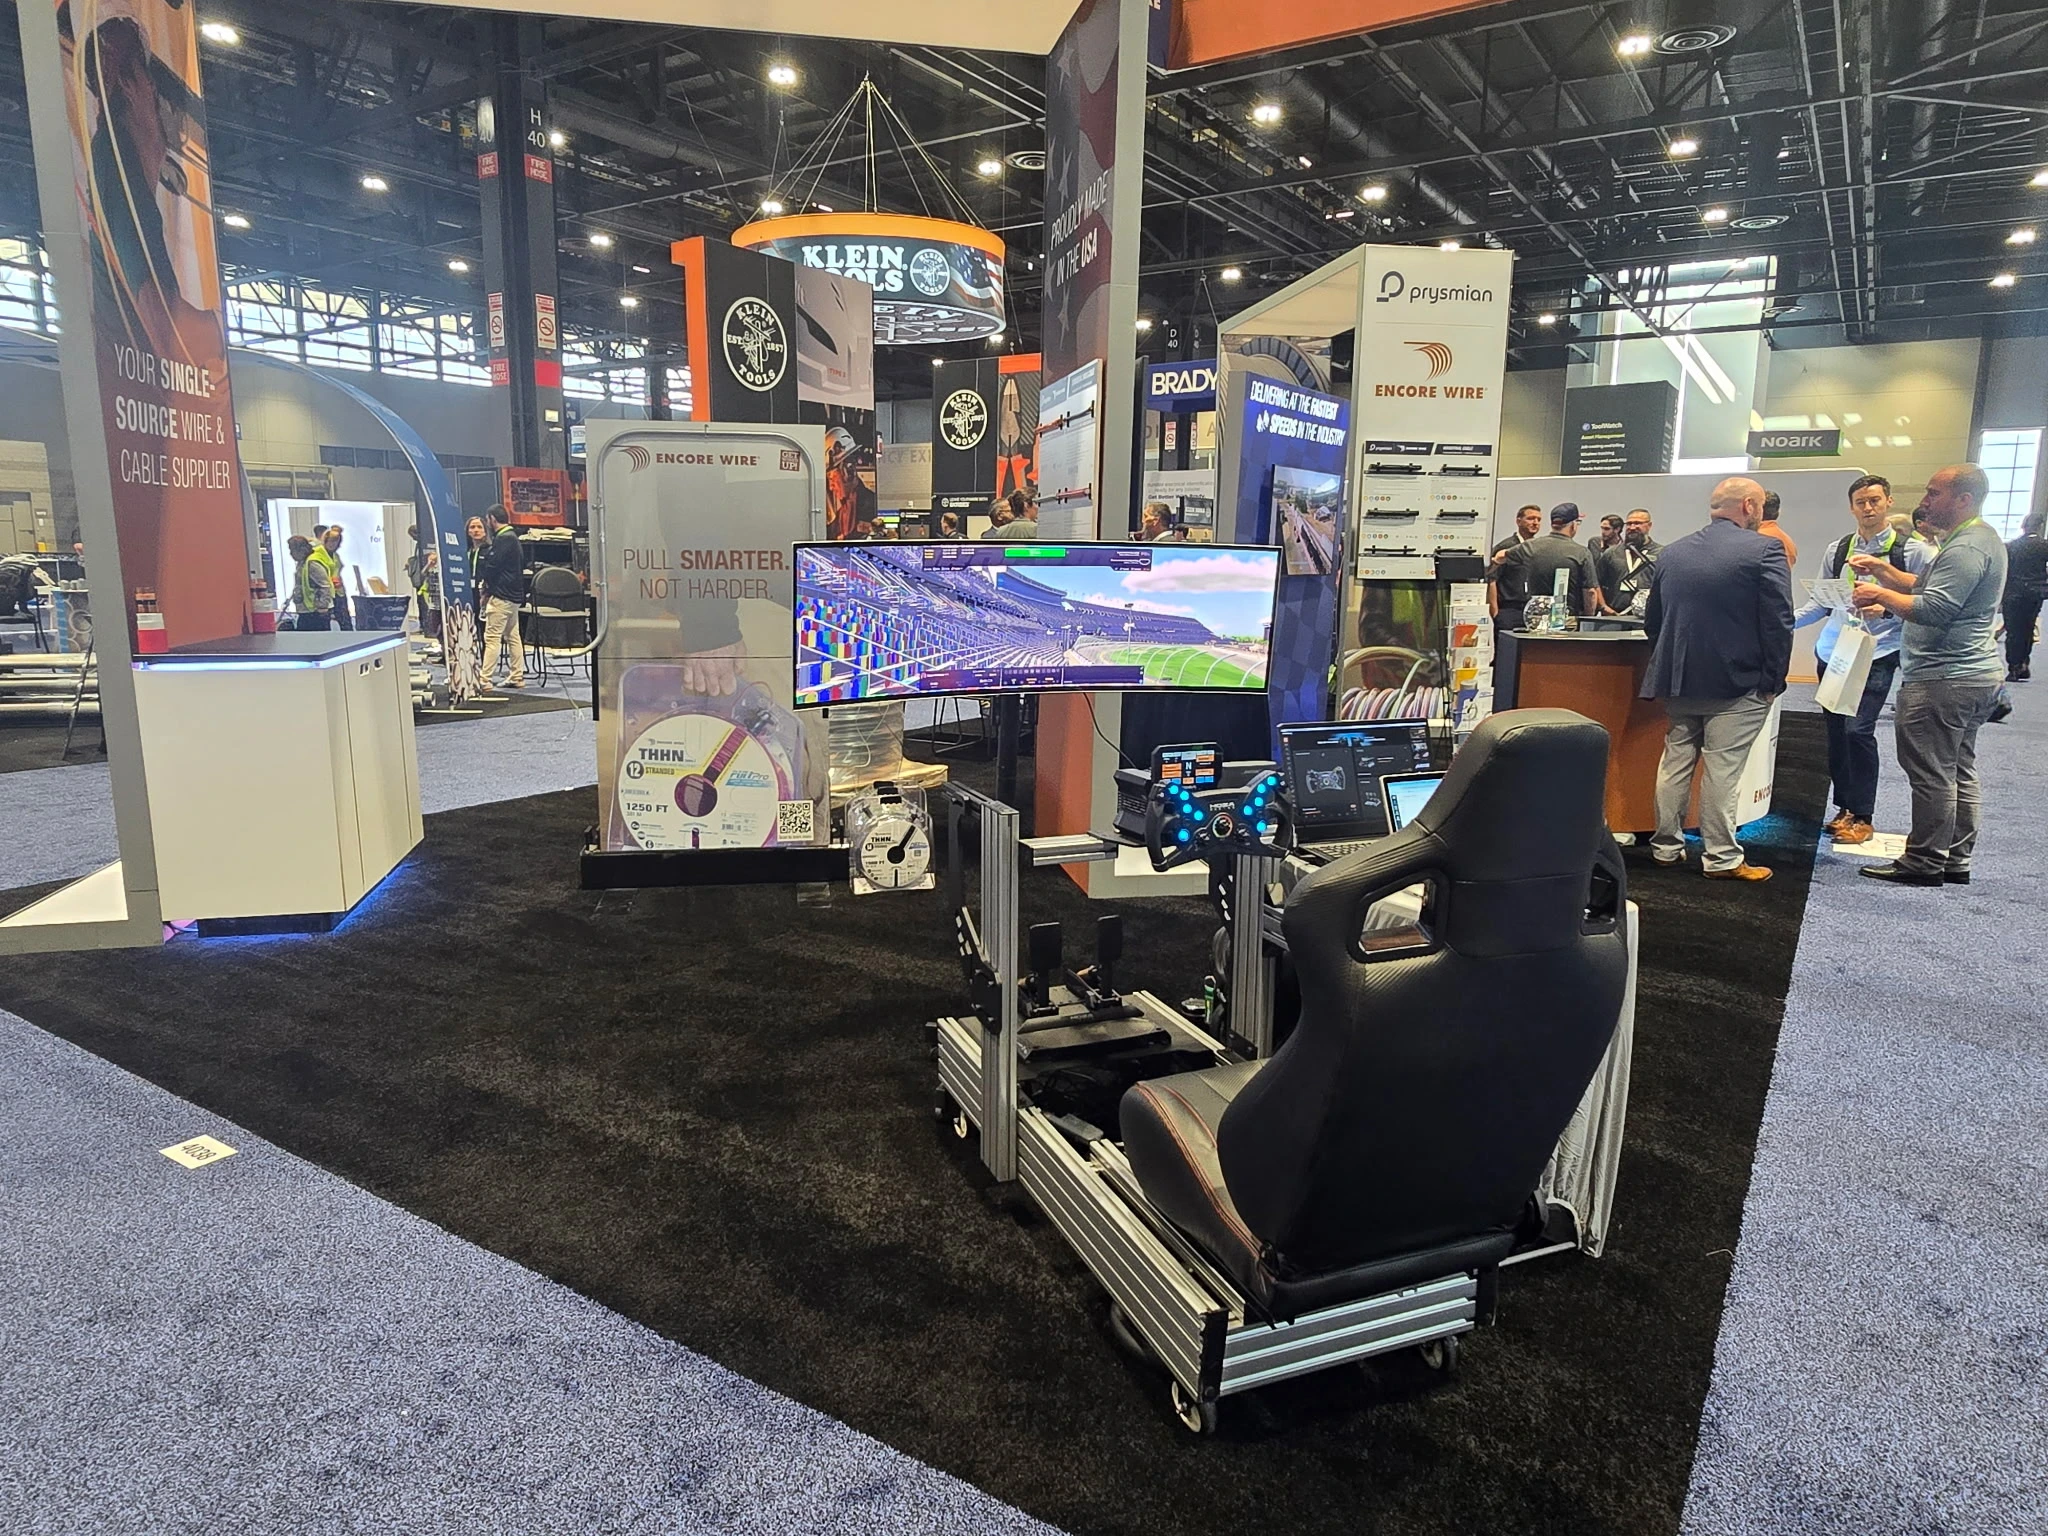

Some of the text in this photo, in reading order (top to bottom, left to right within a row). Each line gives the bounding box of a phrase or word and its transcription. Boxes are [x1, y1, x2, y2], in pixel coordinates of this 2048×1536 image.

[530, 107, 541, 126] H
[527, 130, 546, 148] 40
[1050, 170, 1109, 251] PROUDLY MADE
[802, 245, 905, 270] KLEIN
[1057, 227, 1098, 287] IN THE USA
[1409, 284, 1493, 304] prysmian
[736, 304, 775, 327] KLEIN
[1168, 339, 1178, 348] 40
[1170, 329, 1177, 338] D
[114, 343, 216, 398] YOUR SINGLE-
[738, 364, 776, 386] TOOLS
[1151, 368, 1218, 396] BRADY
[1375, 384, 1485, 399] ENCORE WIRE
[949, 393, 978, 408] KLEIN
[1249, 380, 1340, 420] DELIVERING AT THE FASTEST
[115, 395, 226, 445] SOURCE WIRE &
[1269, 413, 1347, 447] SPEEDS IN THE INDUSTRY
[951, 432, 978, 446] TOOLS
[120, 448, 231, 490] CABLE SUPPLIER
[655, 453, 758, 467] ENCORE WIRE
[623, 549, 791, 572] PULL SMARTER.
[640, 578, 774, 600] NOT HARDER.
[638, 747, 684, 762] THHN
[628, 762, 642, 777] 12
[626, 802, 669, 813] 1250 FT
[180, 1143, 217, 1161] 4038
